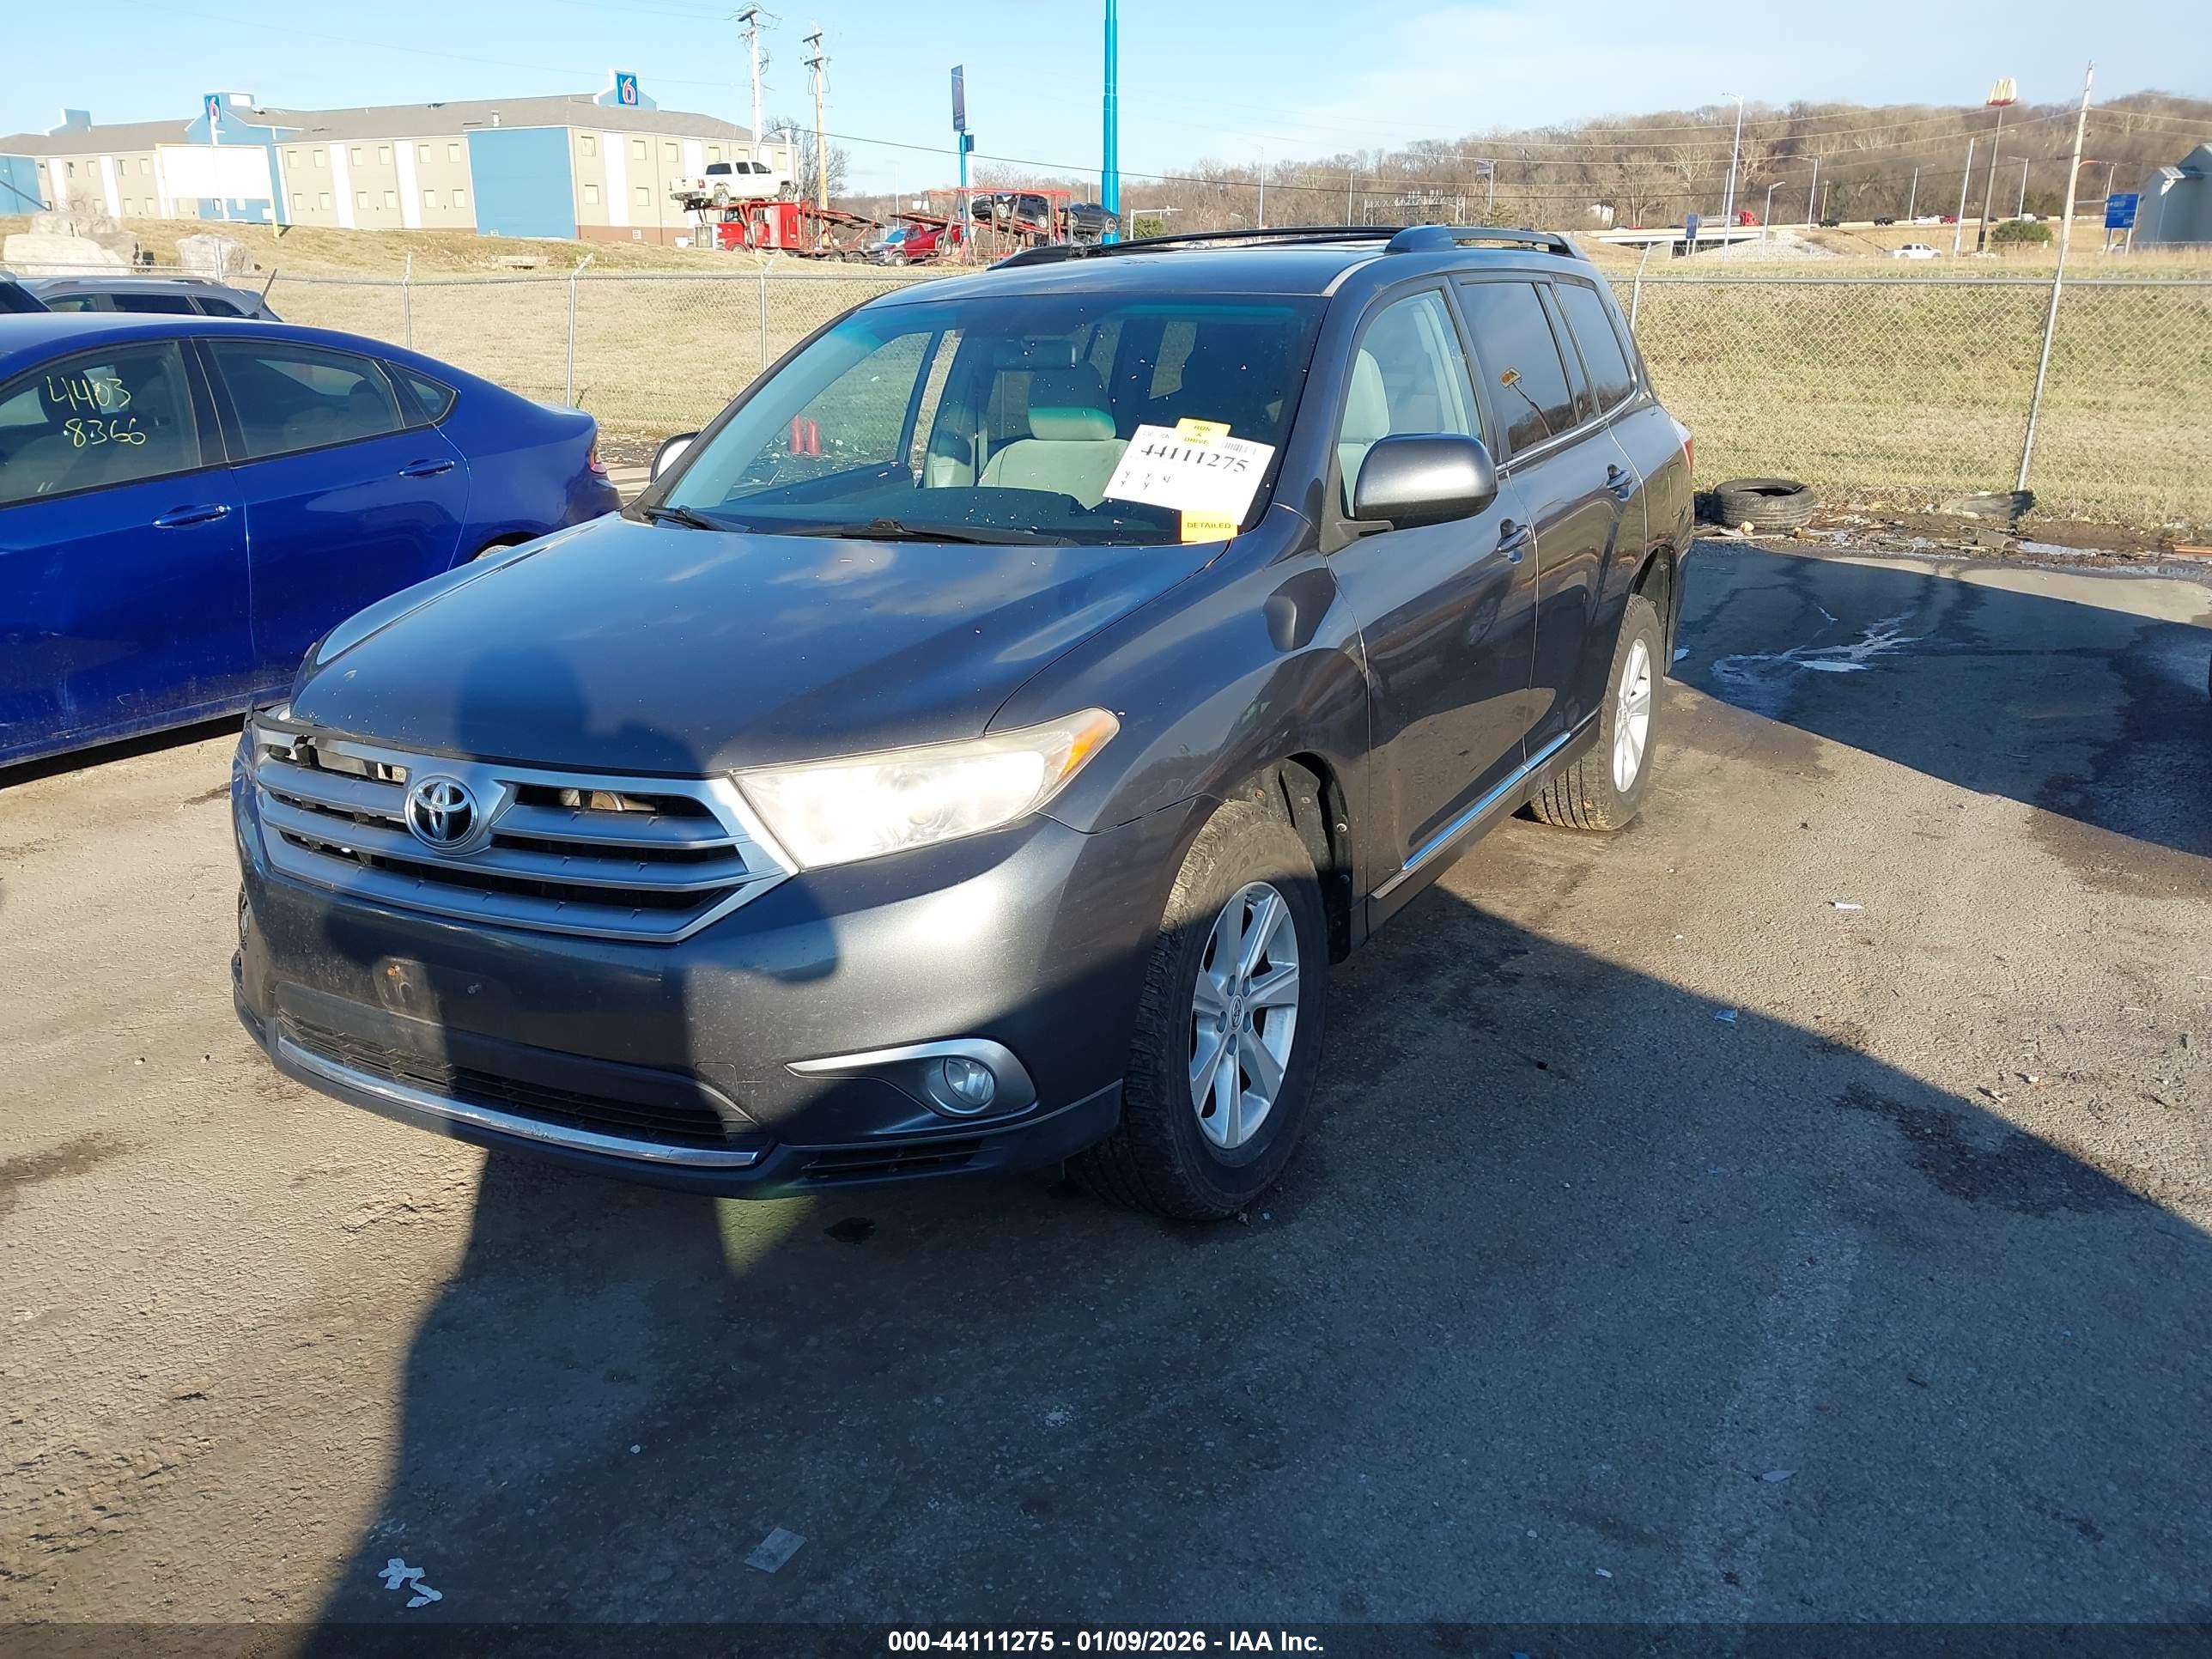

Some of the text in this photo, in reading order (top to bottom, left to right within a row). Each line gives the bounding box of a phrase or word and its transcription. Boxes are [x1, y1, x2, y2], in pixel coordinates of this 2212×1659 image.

[46, 375, 131, 411] 4403
[64, 417, 146, 447] 8366
[1140, 443, 1250, 473] 44111275
